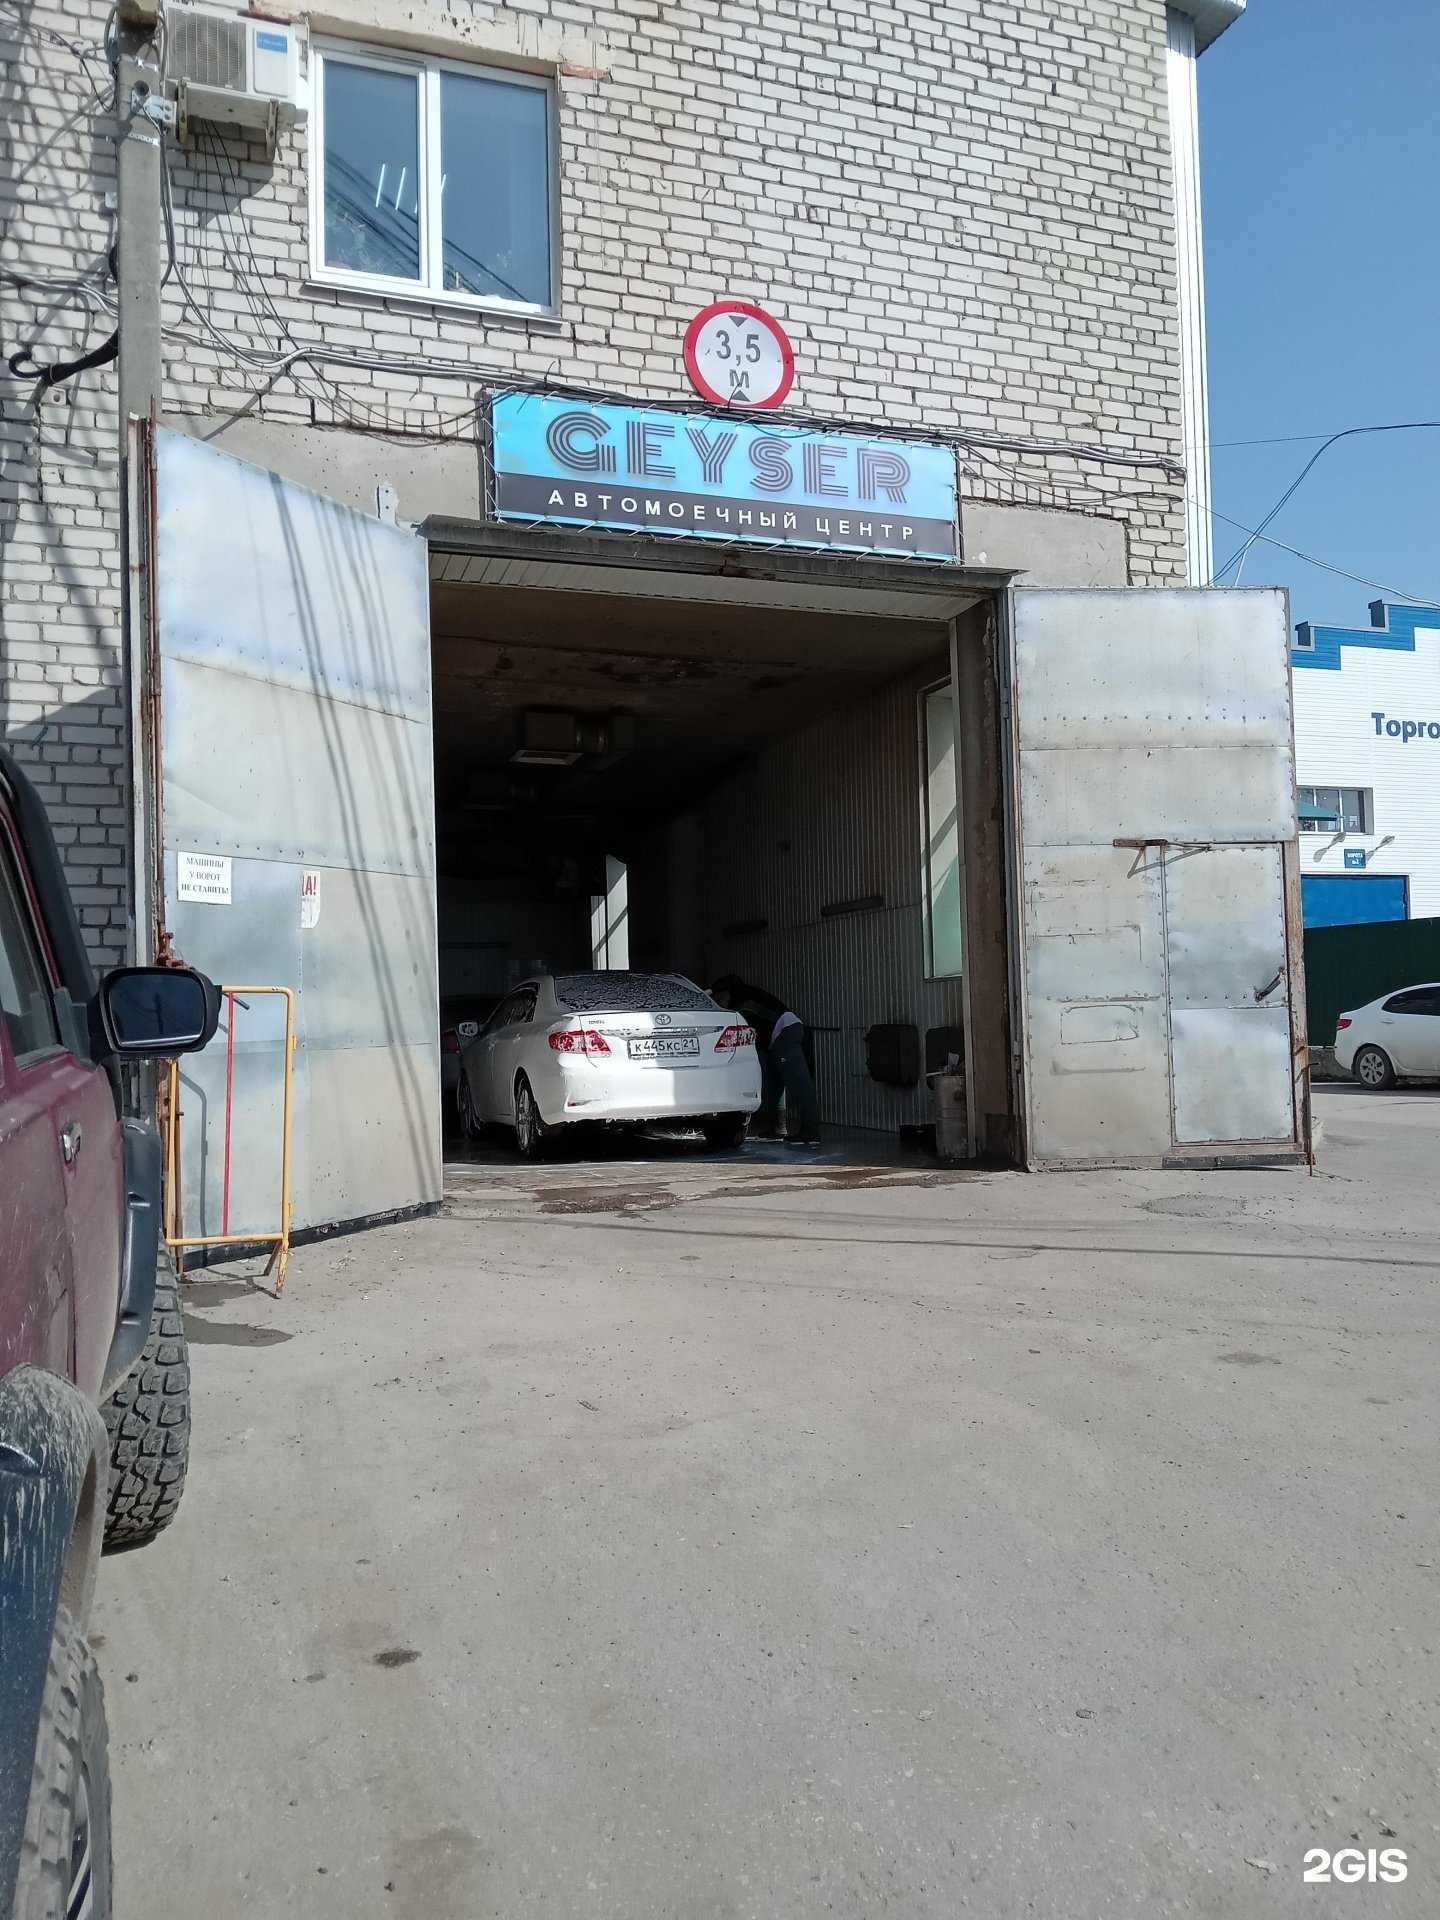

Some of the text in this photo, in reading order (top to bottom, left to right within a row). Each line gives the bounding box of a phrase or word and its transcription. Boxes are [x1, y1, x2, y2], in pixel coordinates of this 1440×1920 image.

[715, 329, 761, 367] 3,5
[545, 410, 912, 504] GEYSER
[548, 489, 915, 541] АВТОМОЕЧНЫЙ ЦЕНТР
